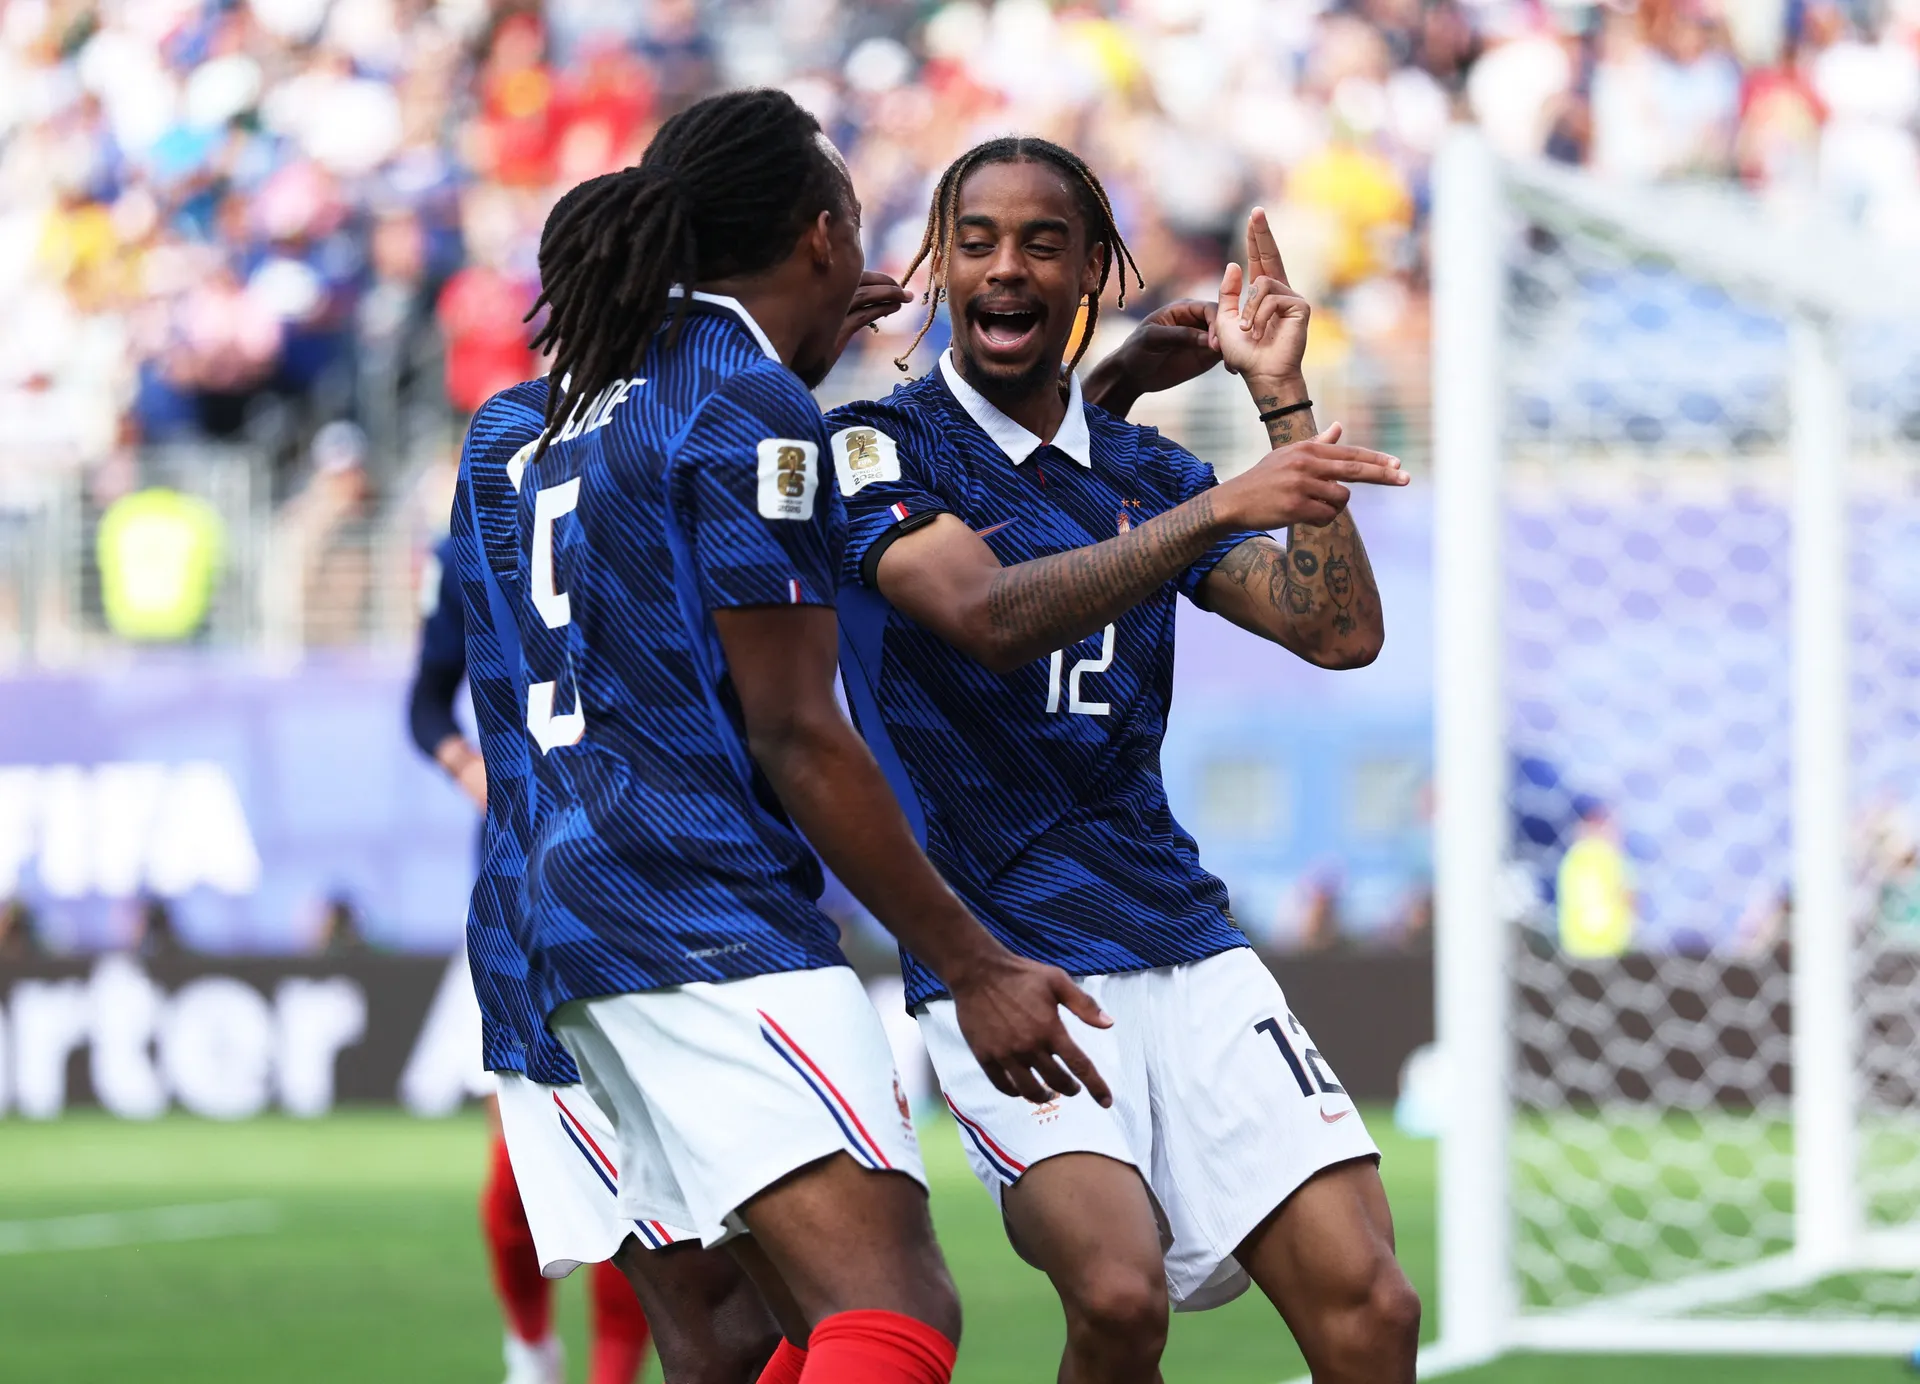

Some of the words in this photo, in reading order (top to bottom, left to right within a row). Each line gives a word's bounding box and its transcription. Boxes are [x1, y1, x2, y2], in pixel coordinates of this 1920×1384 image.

[853, 471, 884, 486] 2026
[1045, 622, 1115, 716] 12
[0, 946, 368, 1119] rter
[1253, 1013, 1348, 1098] 12
